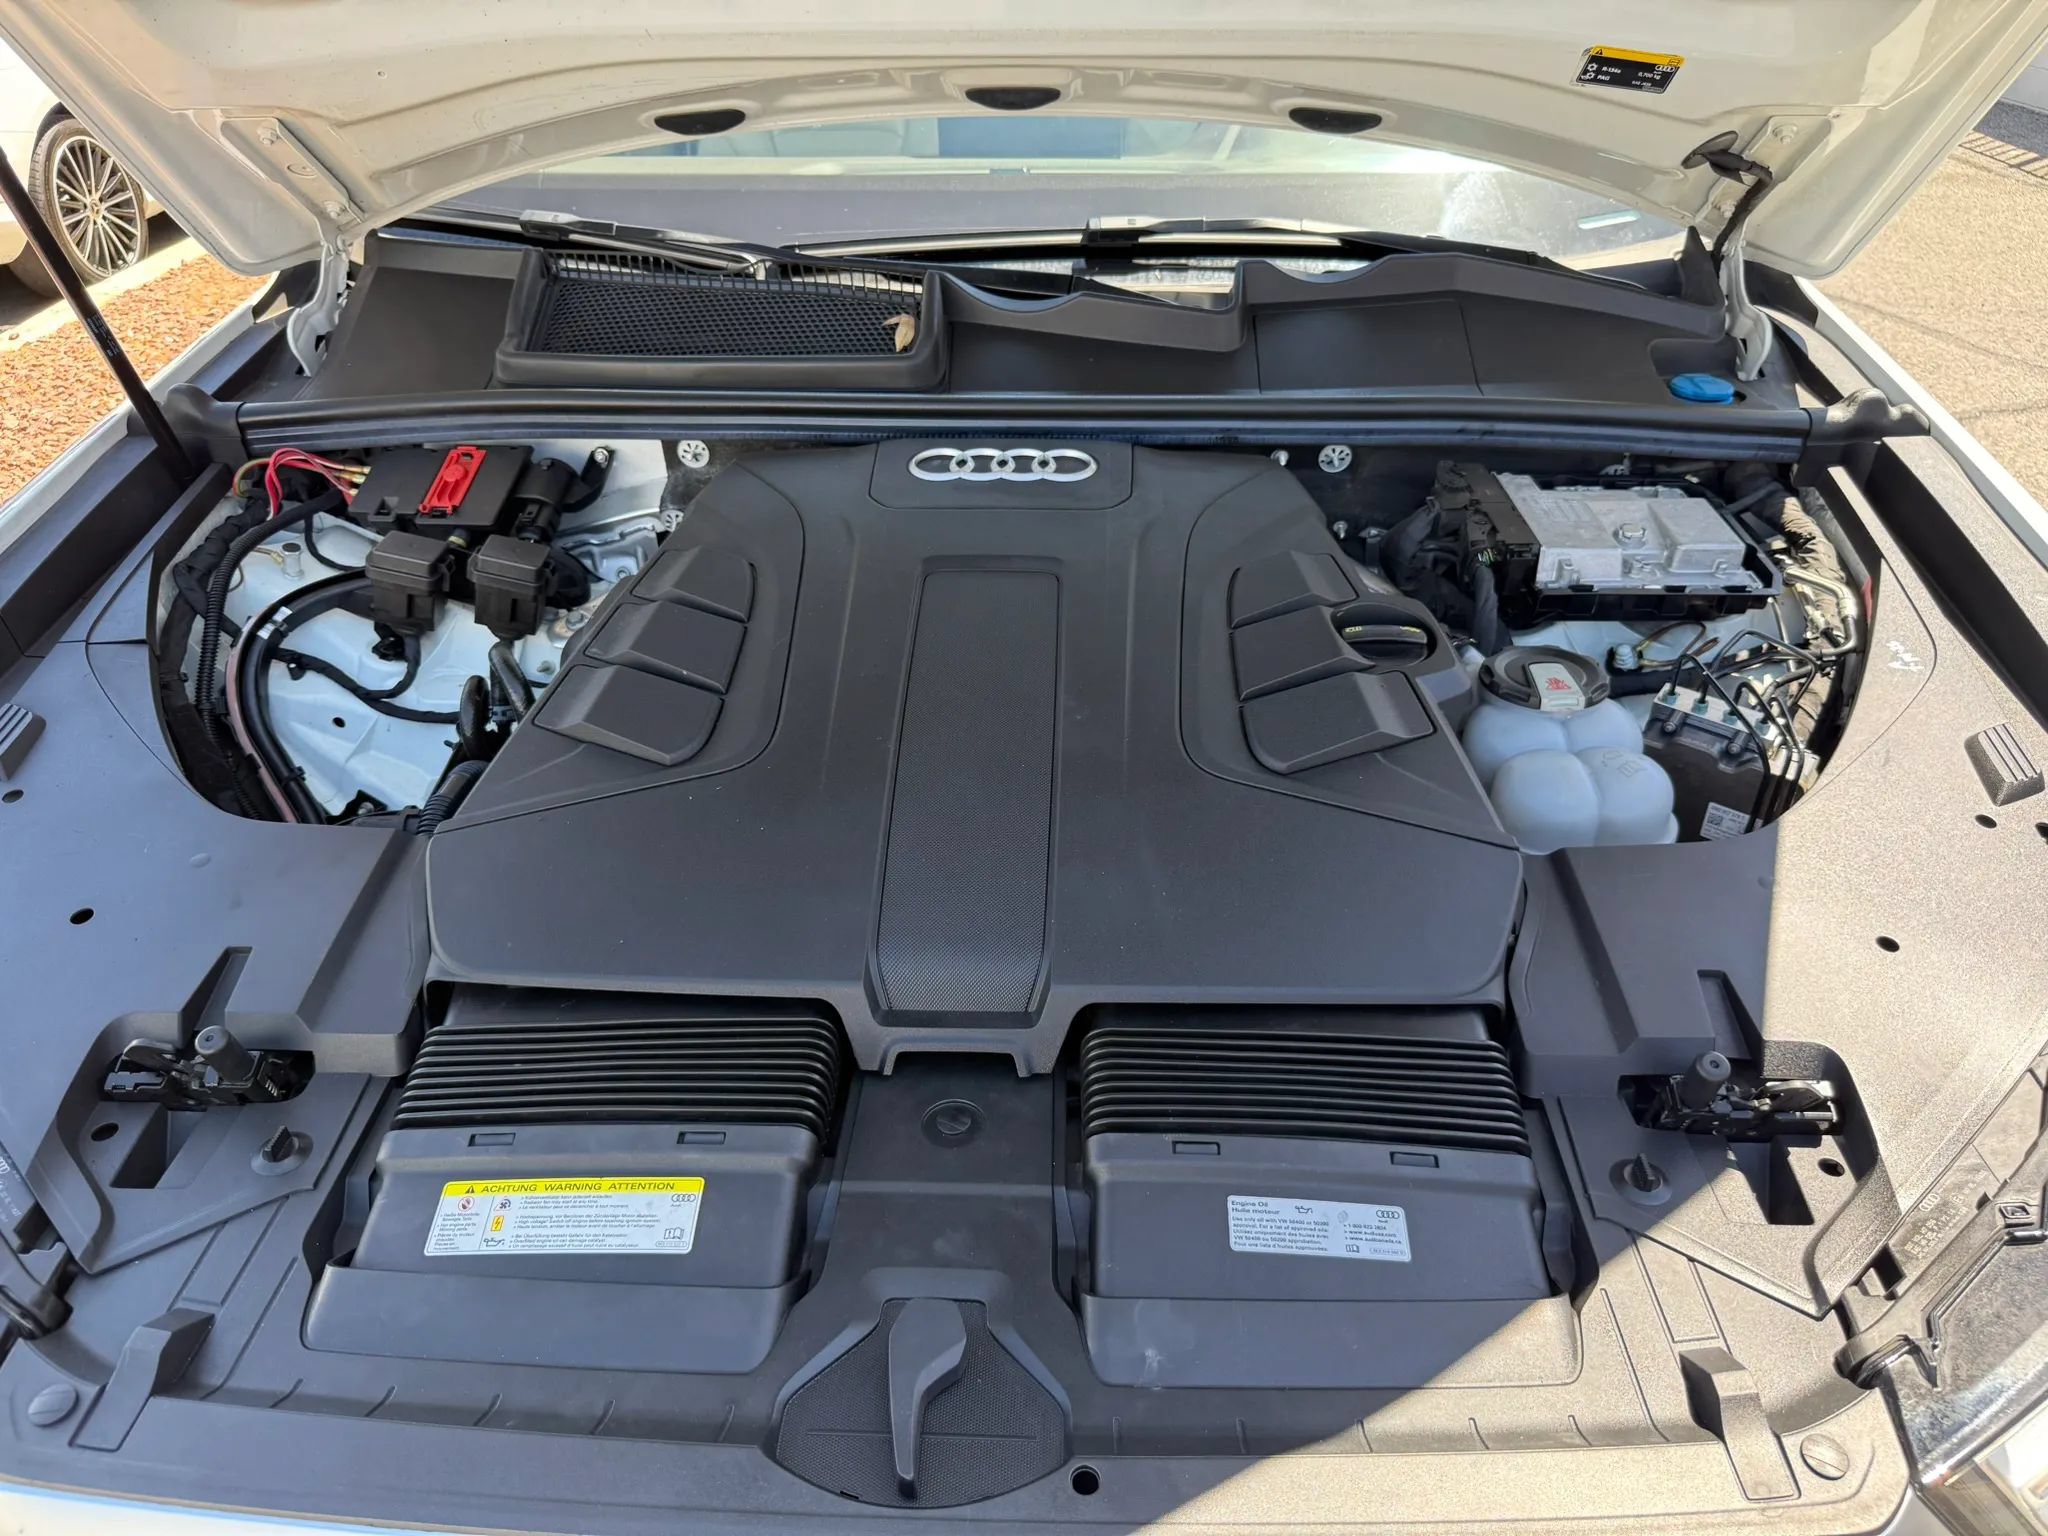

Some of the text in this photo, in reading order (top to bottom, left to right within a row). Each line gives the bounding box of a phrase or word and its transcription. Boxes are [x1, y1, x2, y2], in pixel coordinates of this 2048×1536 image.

[481, 1182, 675, 1193] ACHTUNG WARNING ATTENTION
